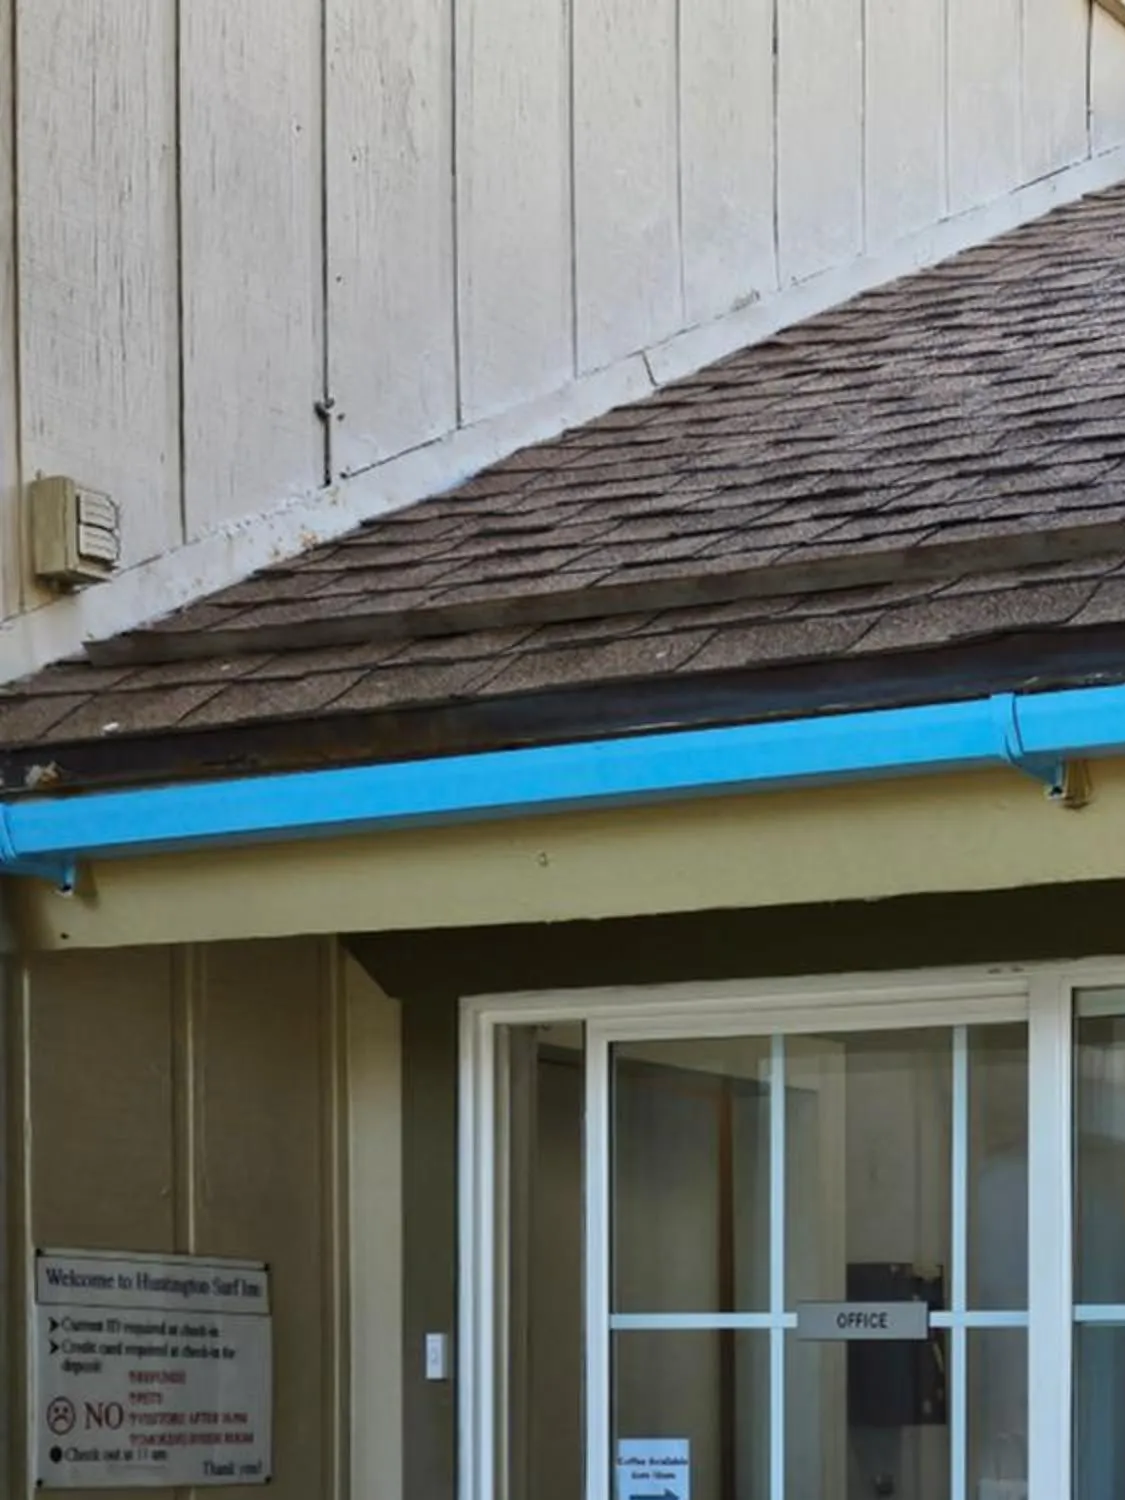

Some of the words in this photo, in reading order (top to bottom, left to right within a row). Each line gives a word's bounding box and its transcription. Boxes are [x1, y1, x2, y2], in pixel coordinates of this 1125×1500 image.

[46, 1268, 114, 1290] Welcome
[117, 1271, 132, 1290] to
[136, 1271, 209, 1297] Huntington
[211, 1277, 239, 1297] Surf
[106, 1318, 121, 1333] ID
[836, 1312, 888, 1329] OFFICE
[99, 1341, 123, 1356] card
[84, 1401, 124, 1431] NO
[65, 1446, 100, 1462] Check
[203, 1460, 234, 1476] Thank
